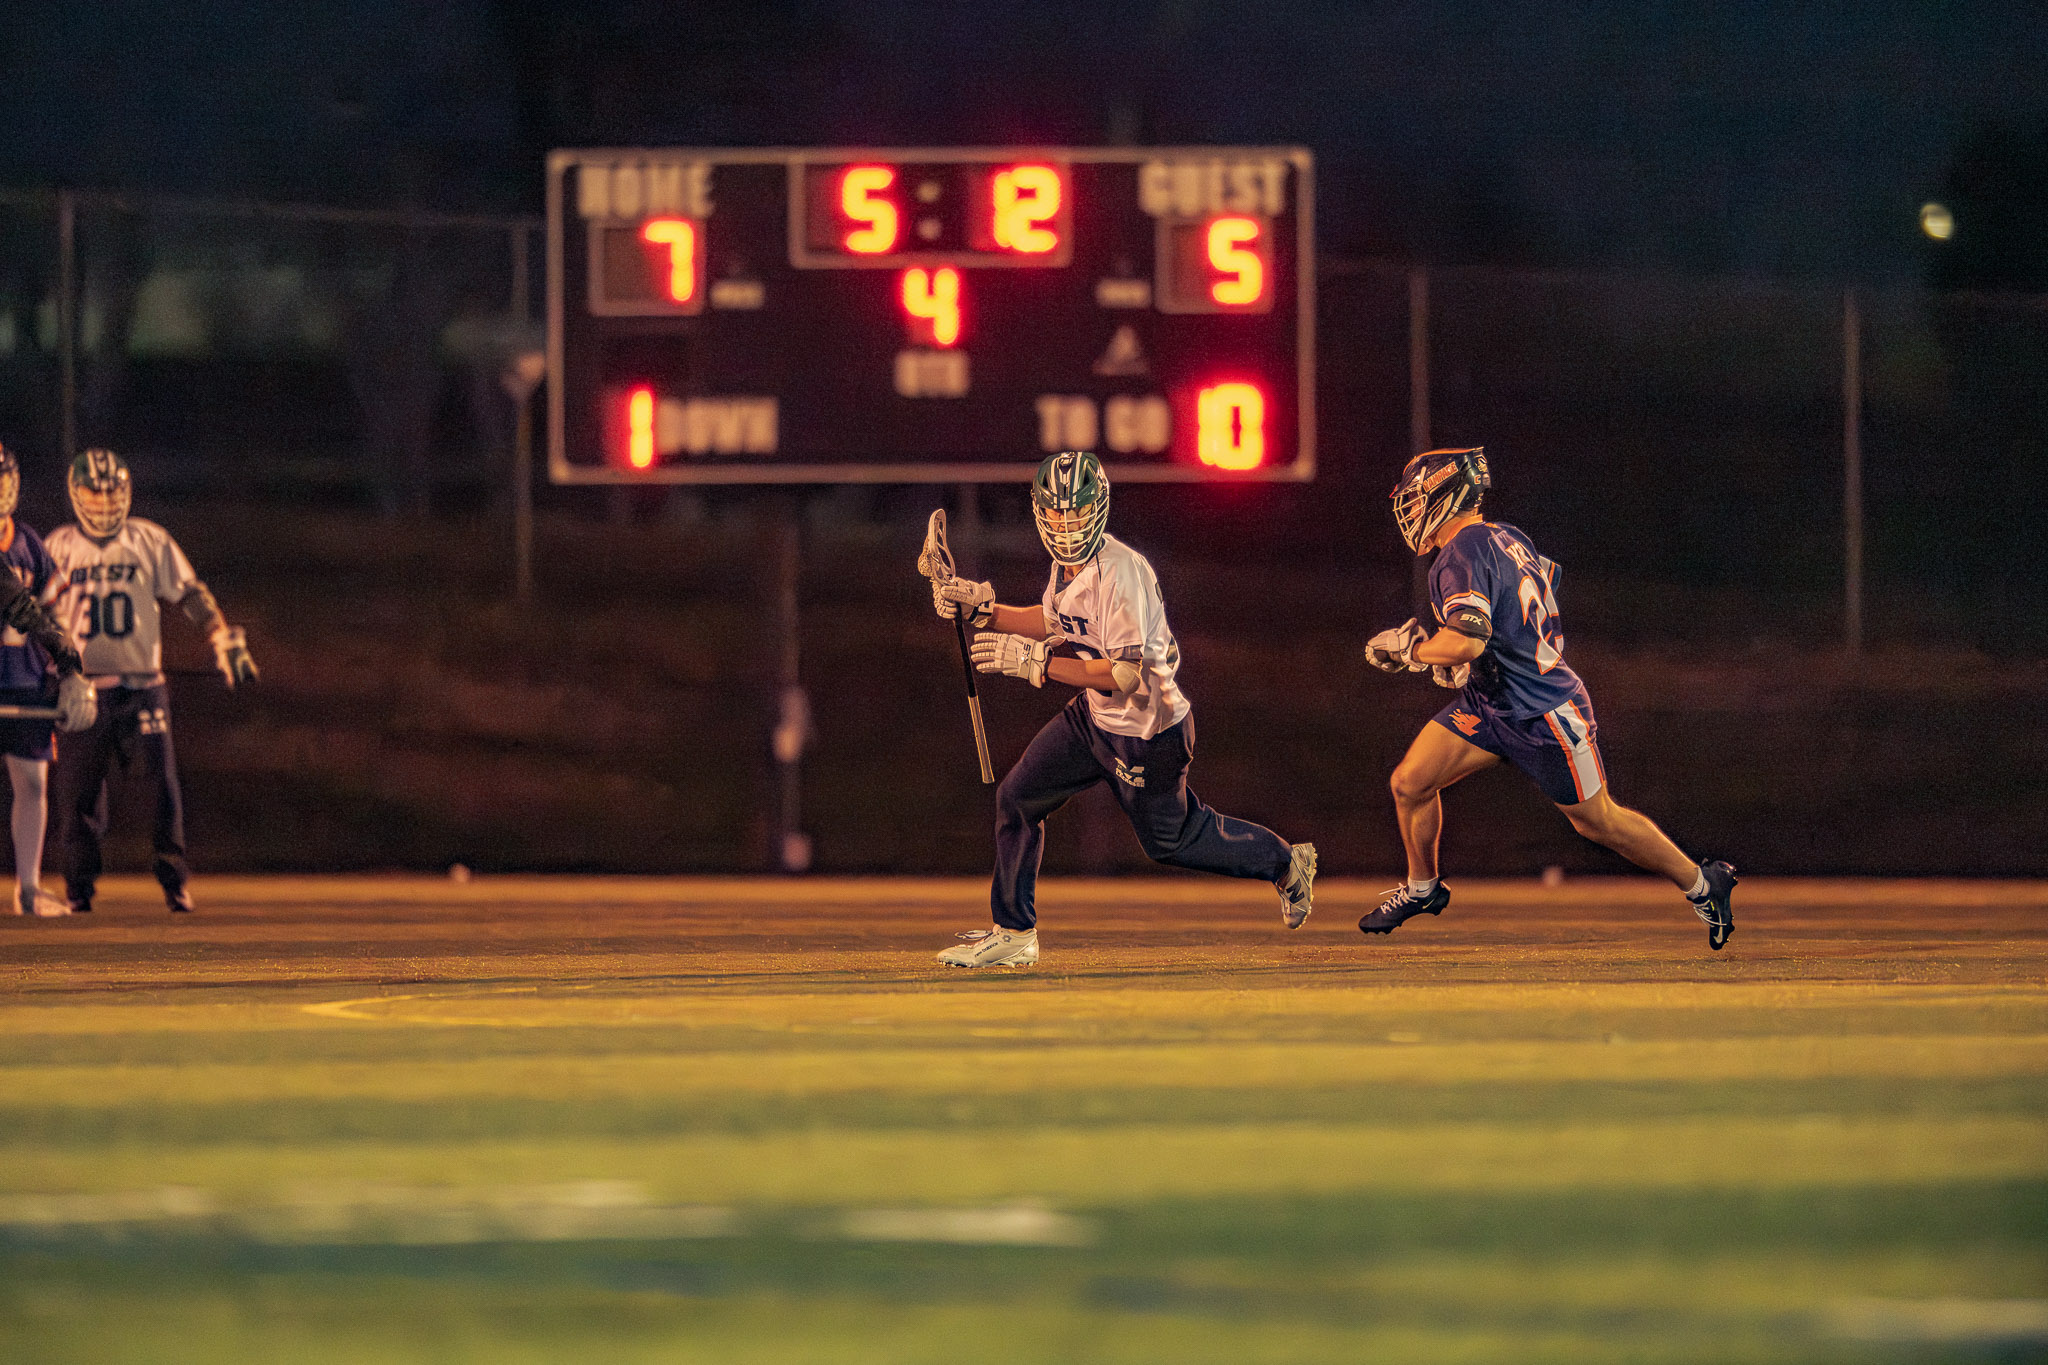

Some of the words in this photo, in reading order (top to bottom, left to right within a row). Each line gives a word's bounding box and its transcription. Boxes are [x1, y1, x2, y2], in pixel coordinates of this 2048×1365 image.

[579, 165, 713, 217] HOME
[1140, 162, 1285, 216] GUEST
[644, 219, 695, 302] 7
[1207, 217, 1263, 304] 5
[902, 267, 959, 345] 4
[629, 389, 654, 468] 1
[656, 398, 779, 454] DOWN
[1037, 396, 1098, 450] TO
[1105, 396, 1173, 452] GO
[1198, 382, 1264, 470] 10
[1422, 461, 1459, 493] RAMPAGE
[78, 591, 134, 639] 30
[1058, 612, 1089, 636] ST
[1460, 613, 1483, 626] STX
